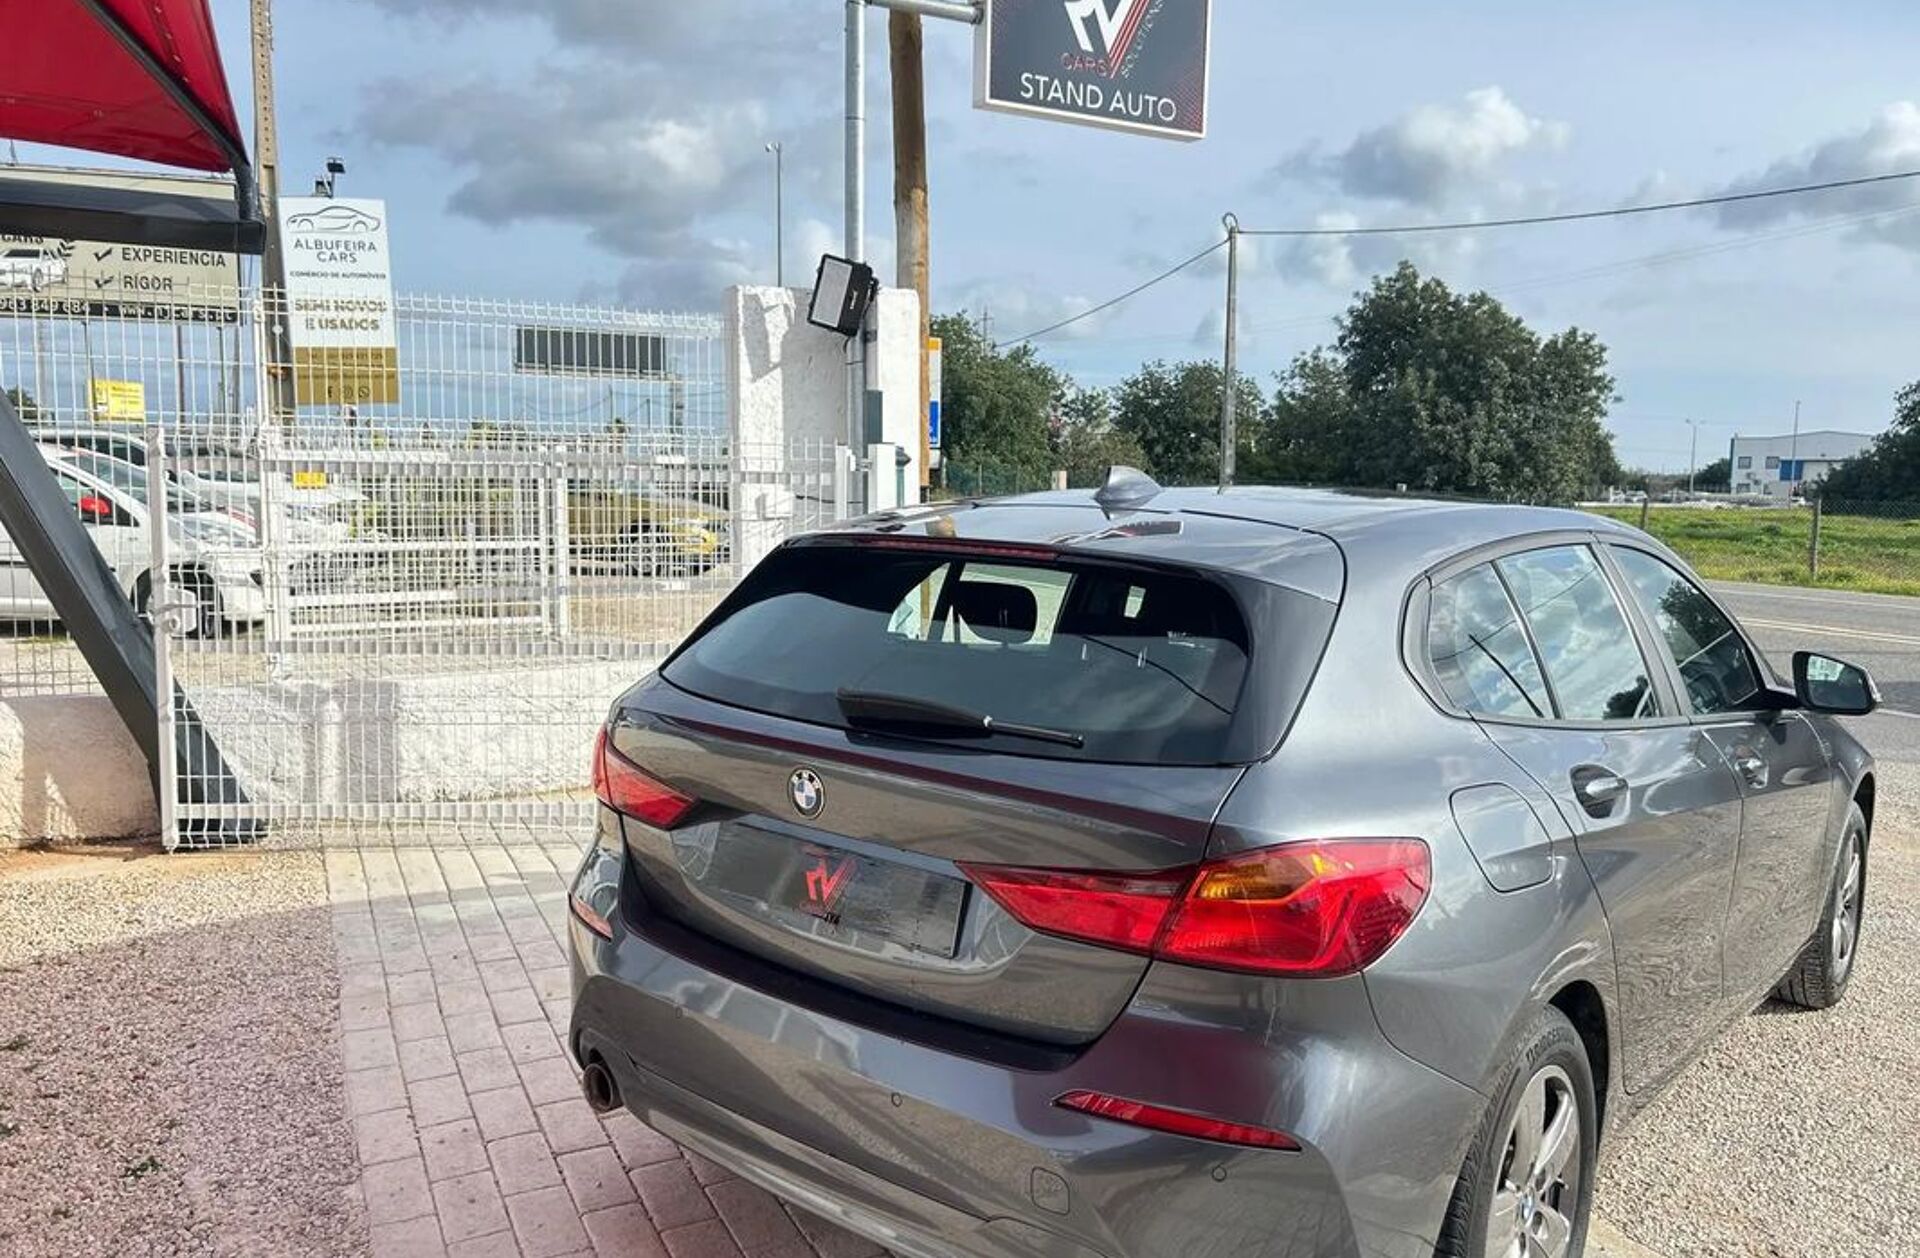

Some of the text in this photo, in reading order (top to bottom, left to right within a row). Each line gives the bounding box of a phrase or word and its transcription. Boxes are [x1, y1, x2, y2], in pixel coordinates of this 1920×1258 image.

[1060, 52, 1107, 78] CARS
[1020, 72, 1177, 122] STAND AUTO
[293, 238, 378, 252] ALBUFEIRA
[121, 247, 227, 268] EXPERIENCIA
[316, 251, 358, 264] CARS
[123, 275, 174, 291] RIGOR
[318, 318, 380, 332] USADOS
